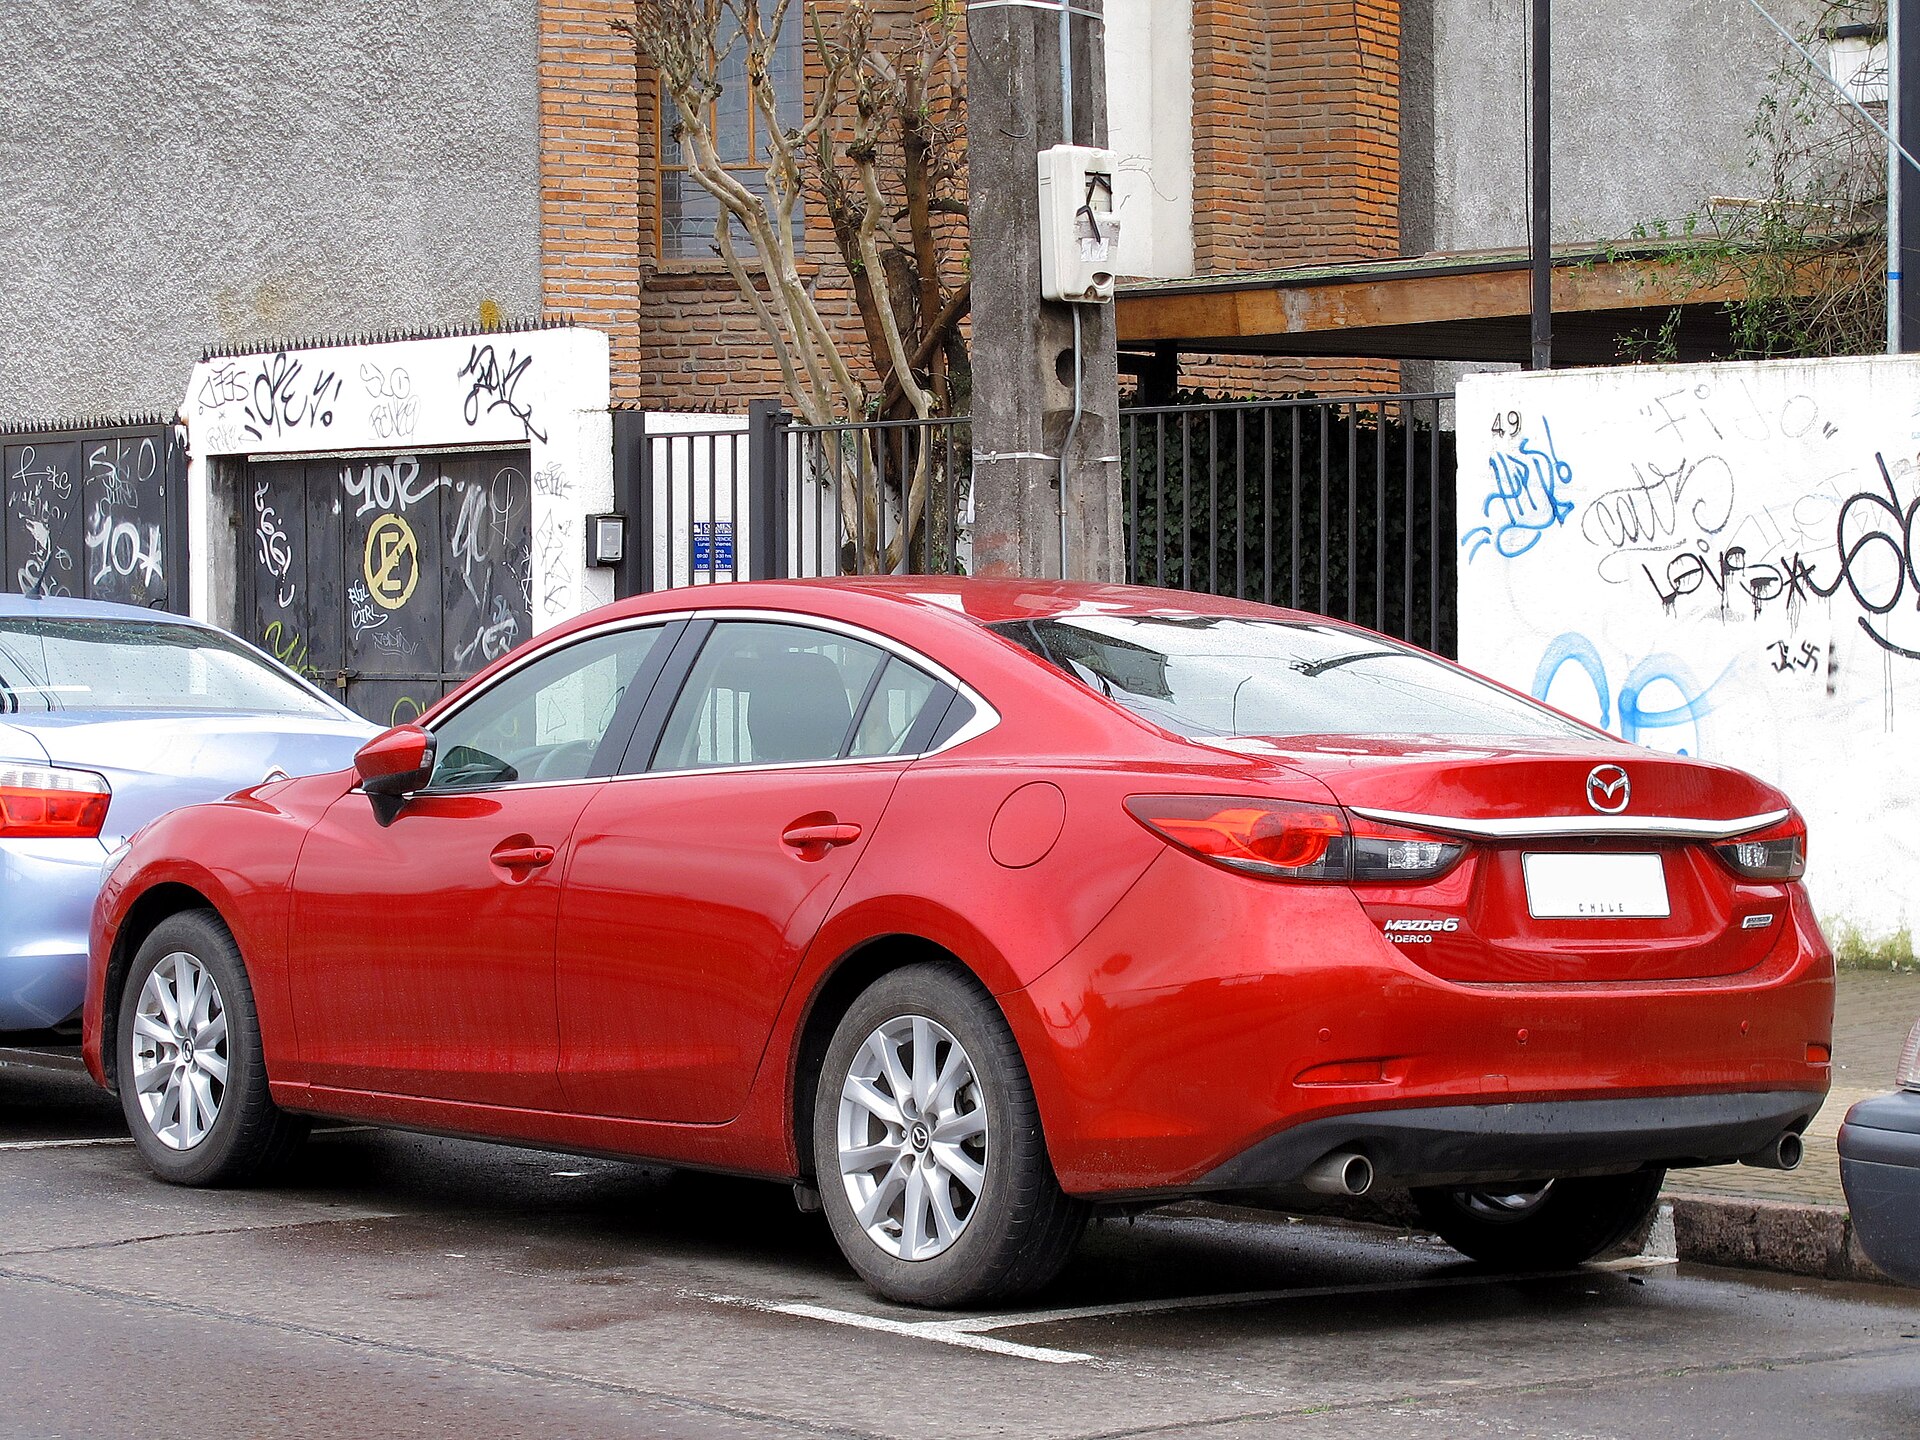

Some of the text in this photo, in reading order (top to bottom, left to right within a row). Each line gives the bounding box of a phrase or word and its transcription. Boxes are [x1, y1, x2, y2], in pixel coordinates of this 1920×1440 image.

[1491, 411, 1522, 438] 49
[1578, 902, 1624, 913] CHILE
[1394, 934, 1433, 943] DERCO
